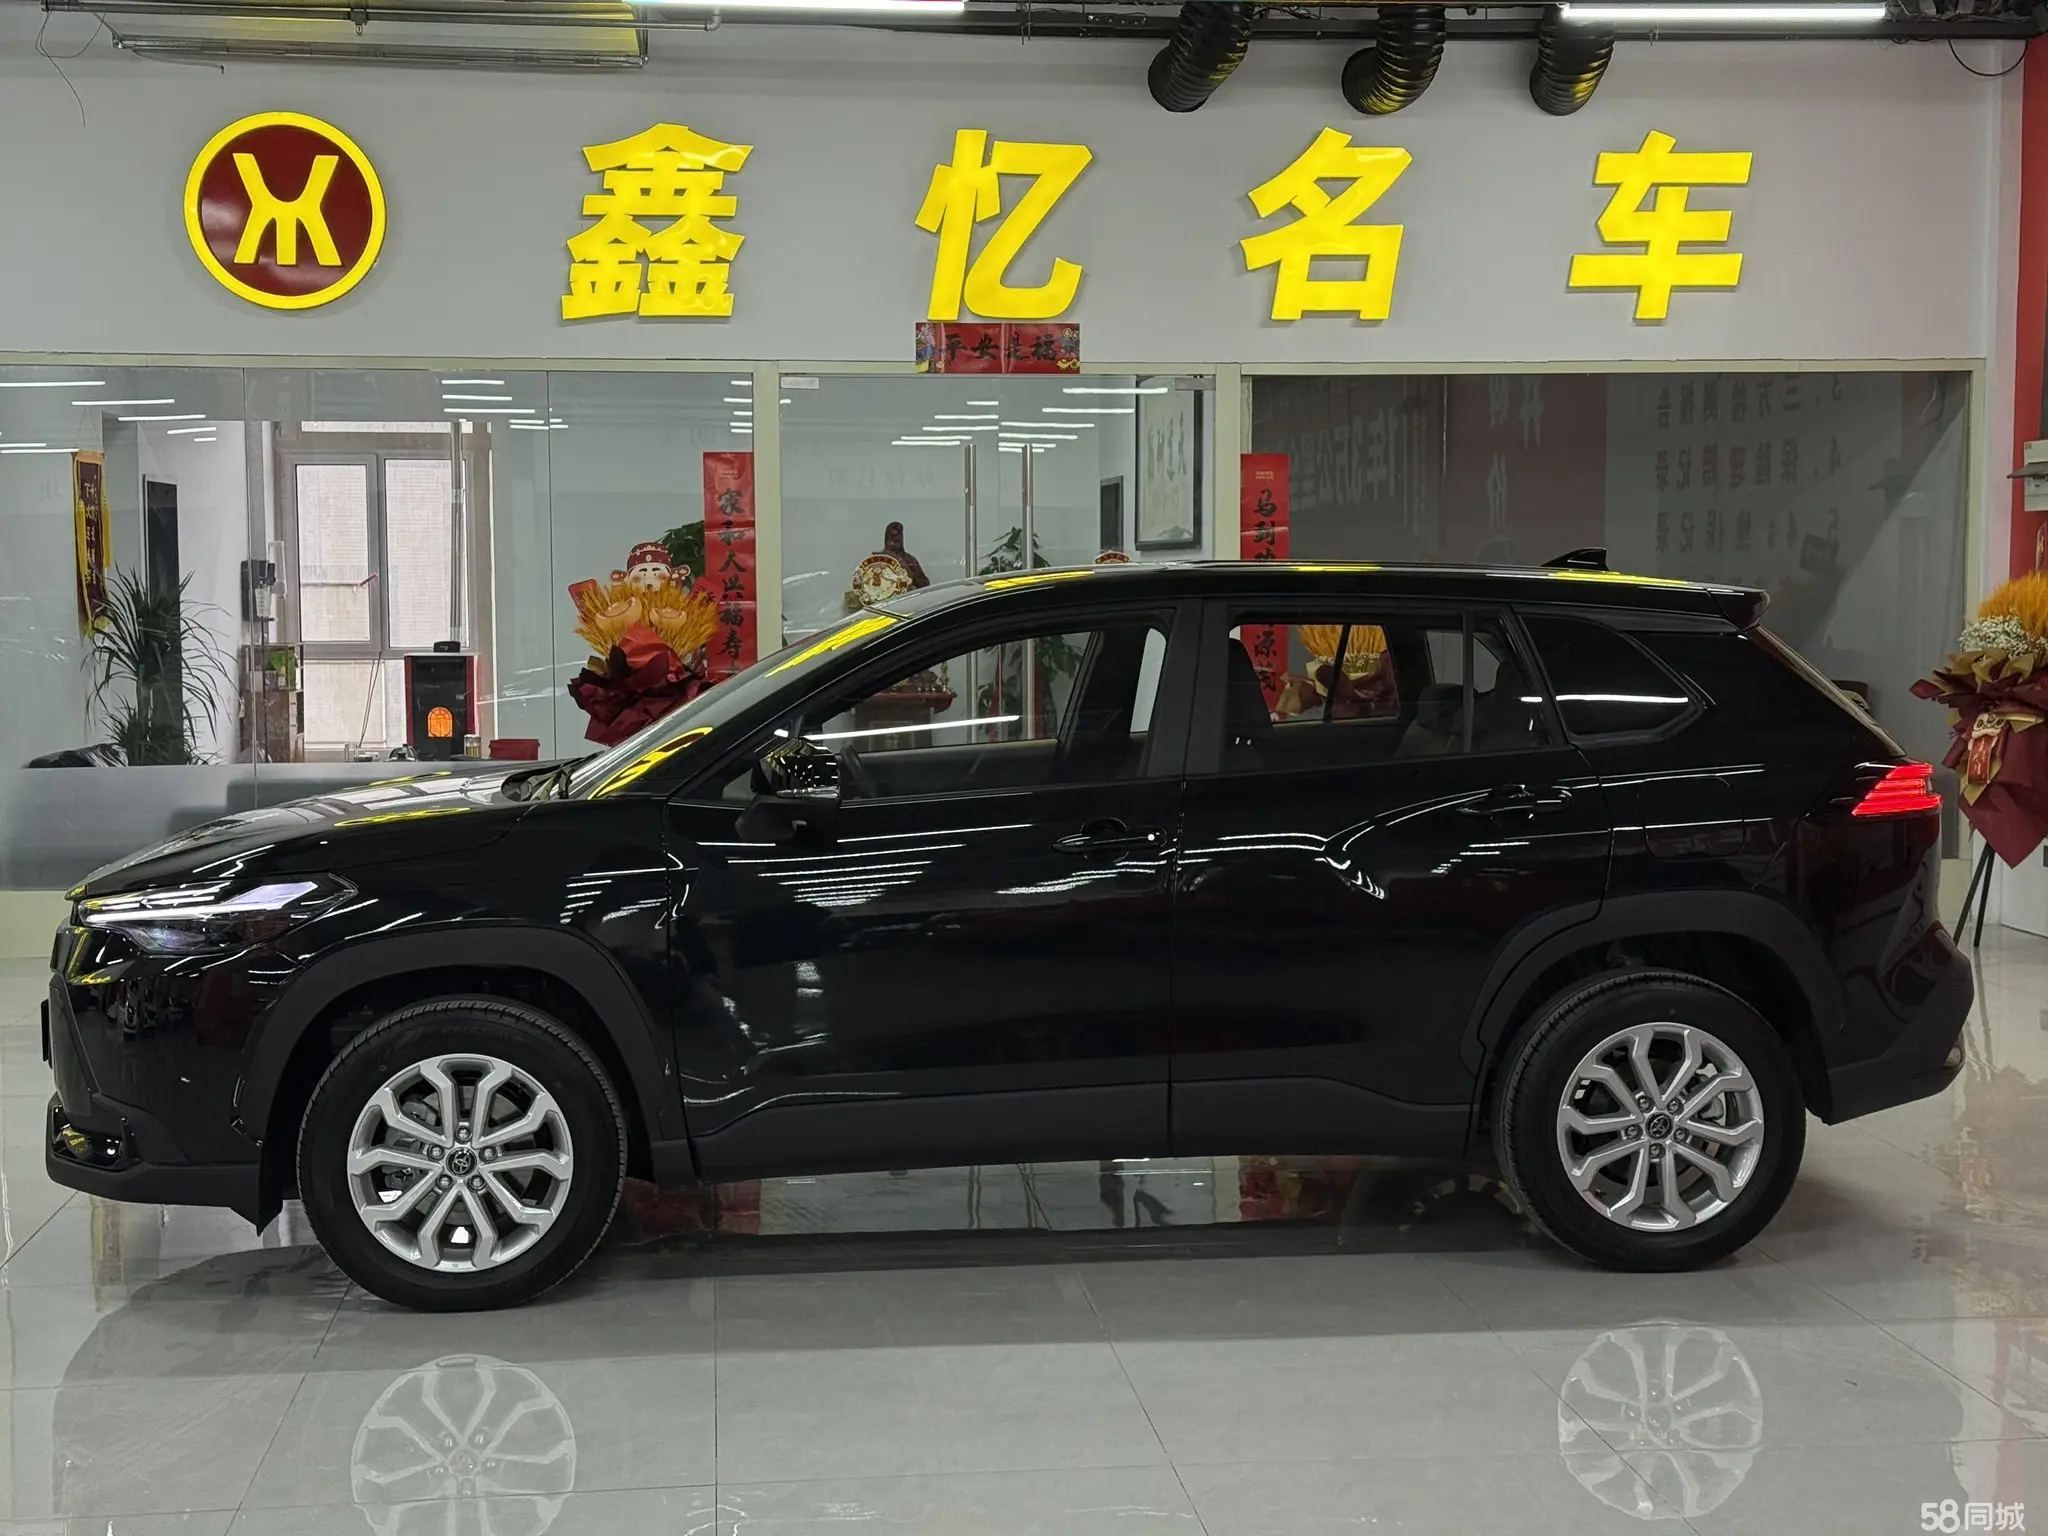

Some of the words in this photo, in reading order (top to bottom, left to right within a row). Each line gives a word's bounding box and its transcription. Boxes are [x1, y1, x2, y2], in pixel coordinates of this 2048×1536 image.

[561, 122, 1754, 322] 鑫忆名车
[938, 331, 1057, 362] 平安是福
